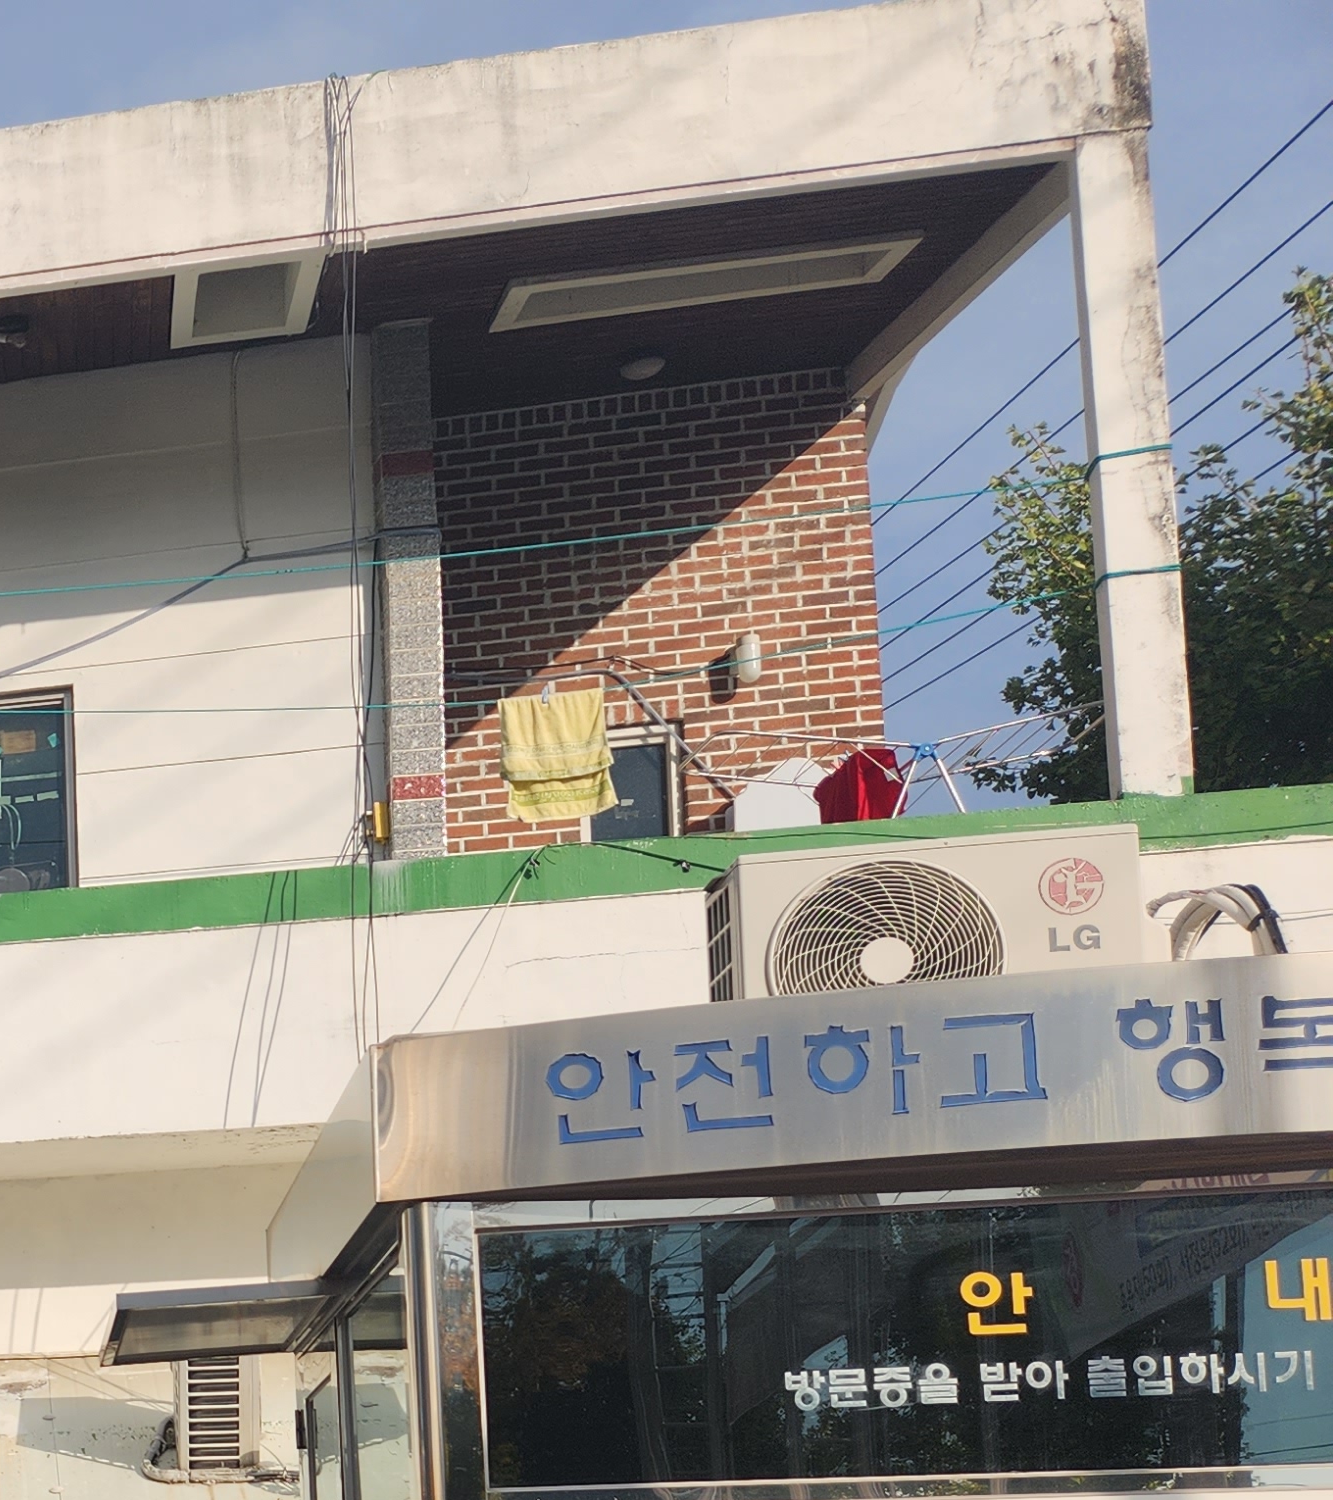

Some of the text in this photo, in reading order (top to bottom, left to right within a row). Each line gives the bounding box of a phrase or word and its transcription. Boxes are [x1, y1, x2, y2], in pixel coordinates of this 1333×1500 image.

[1048, 924, 1101, 953] LG
[545, 1011, 1048, 1146] 안전하고
[960, 1258, 1332, 1336] 안 내
[784, 1350, 1315, 1412] 방문증을 받아 출입하시기
